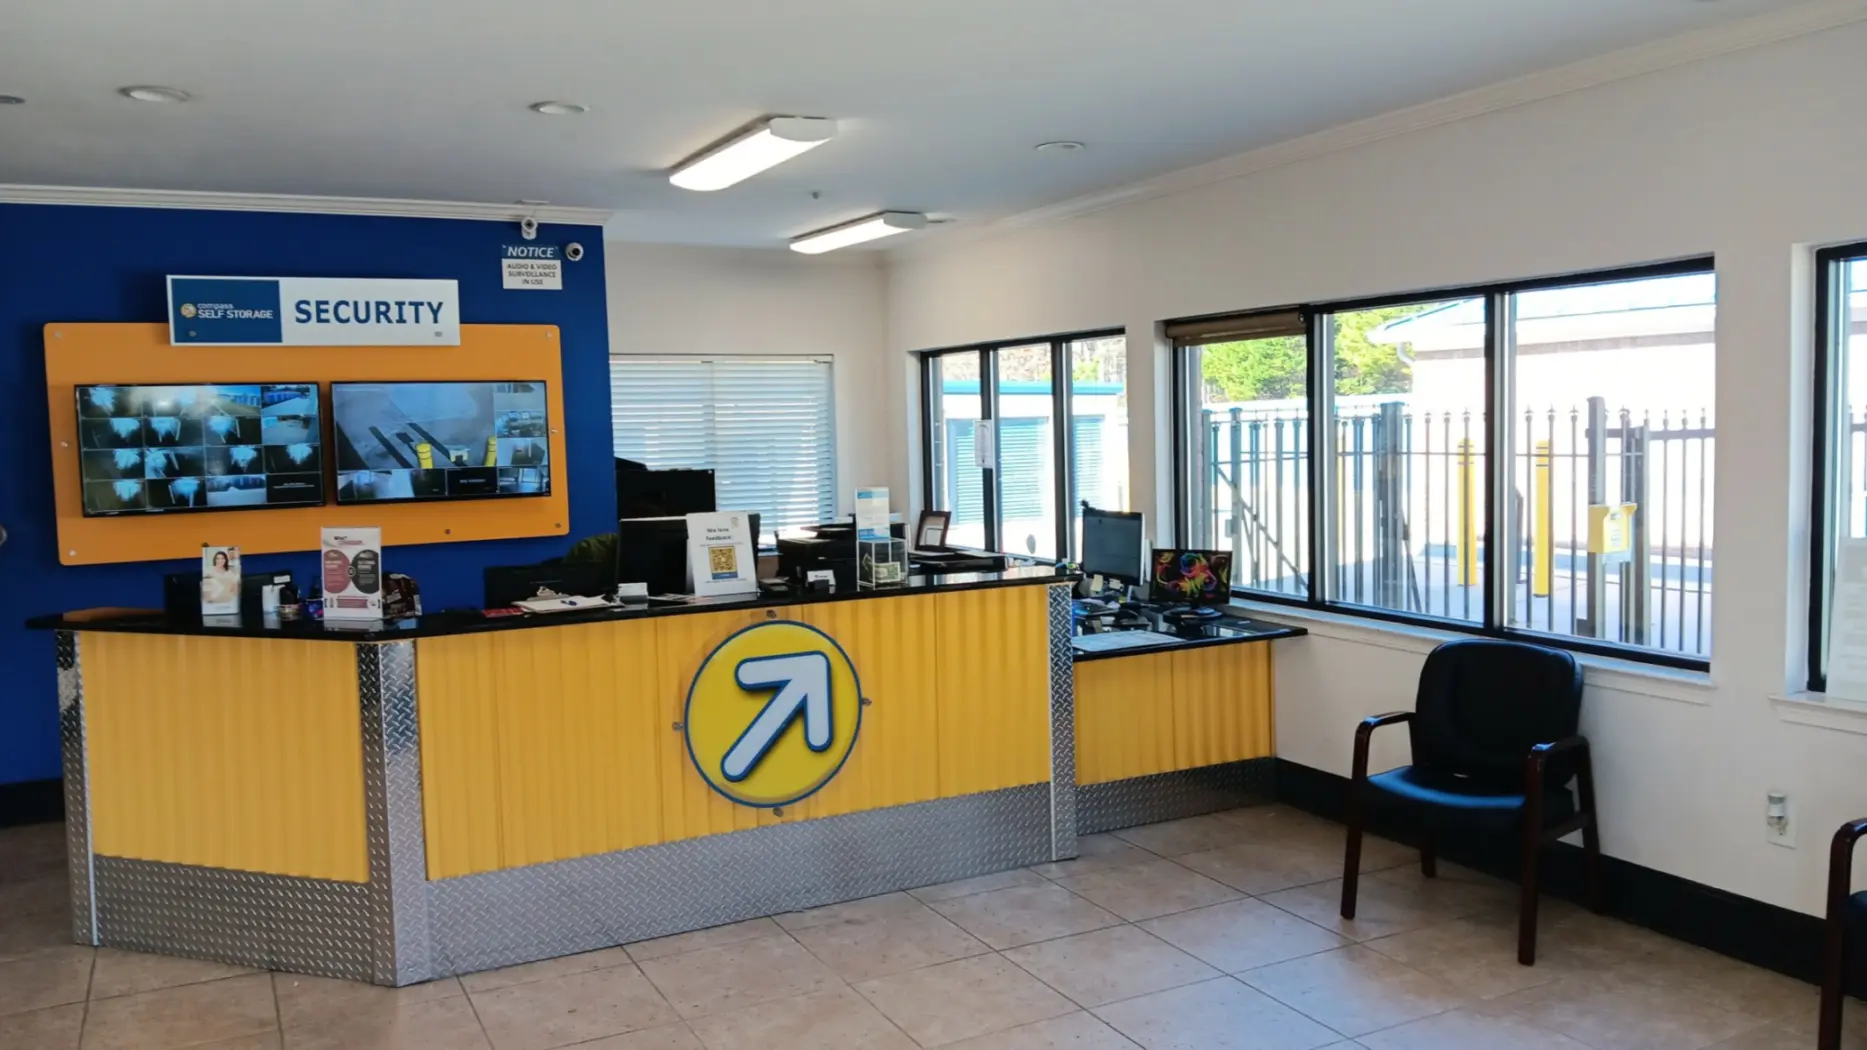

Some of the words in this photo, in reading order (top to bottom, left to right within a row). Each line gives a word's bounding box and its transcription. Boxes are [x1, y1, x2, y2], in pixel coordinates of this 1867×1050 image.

[508, 246, 554, 258] NOTICE
[507, 270, 557, 278] SURVEILLANCE
[197, 309, 225, 319] SELF
[226, 309, 274, 319] STORAGE
[294, 299, 444, 324] SECURITY
